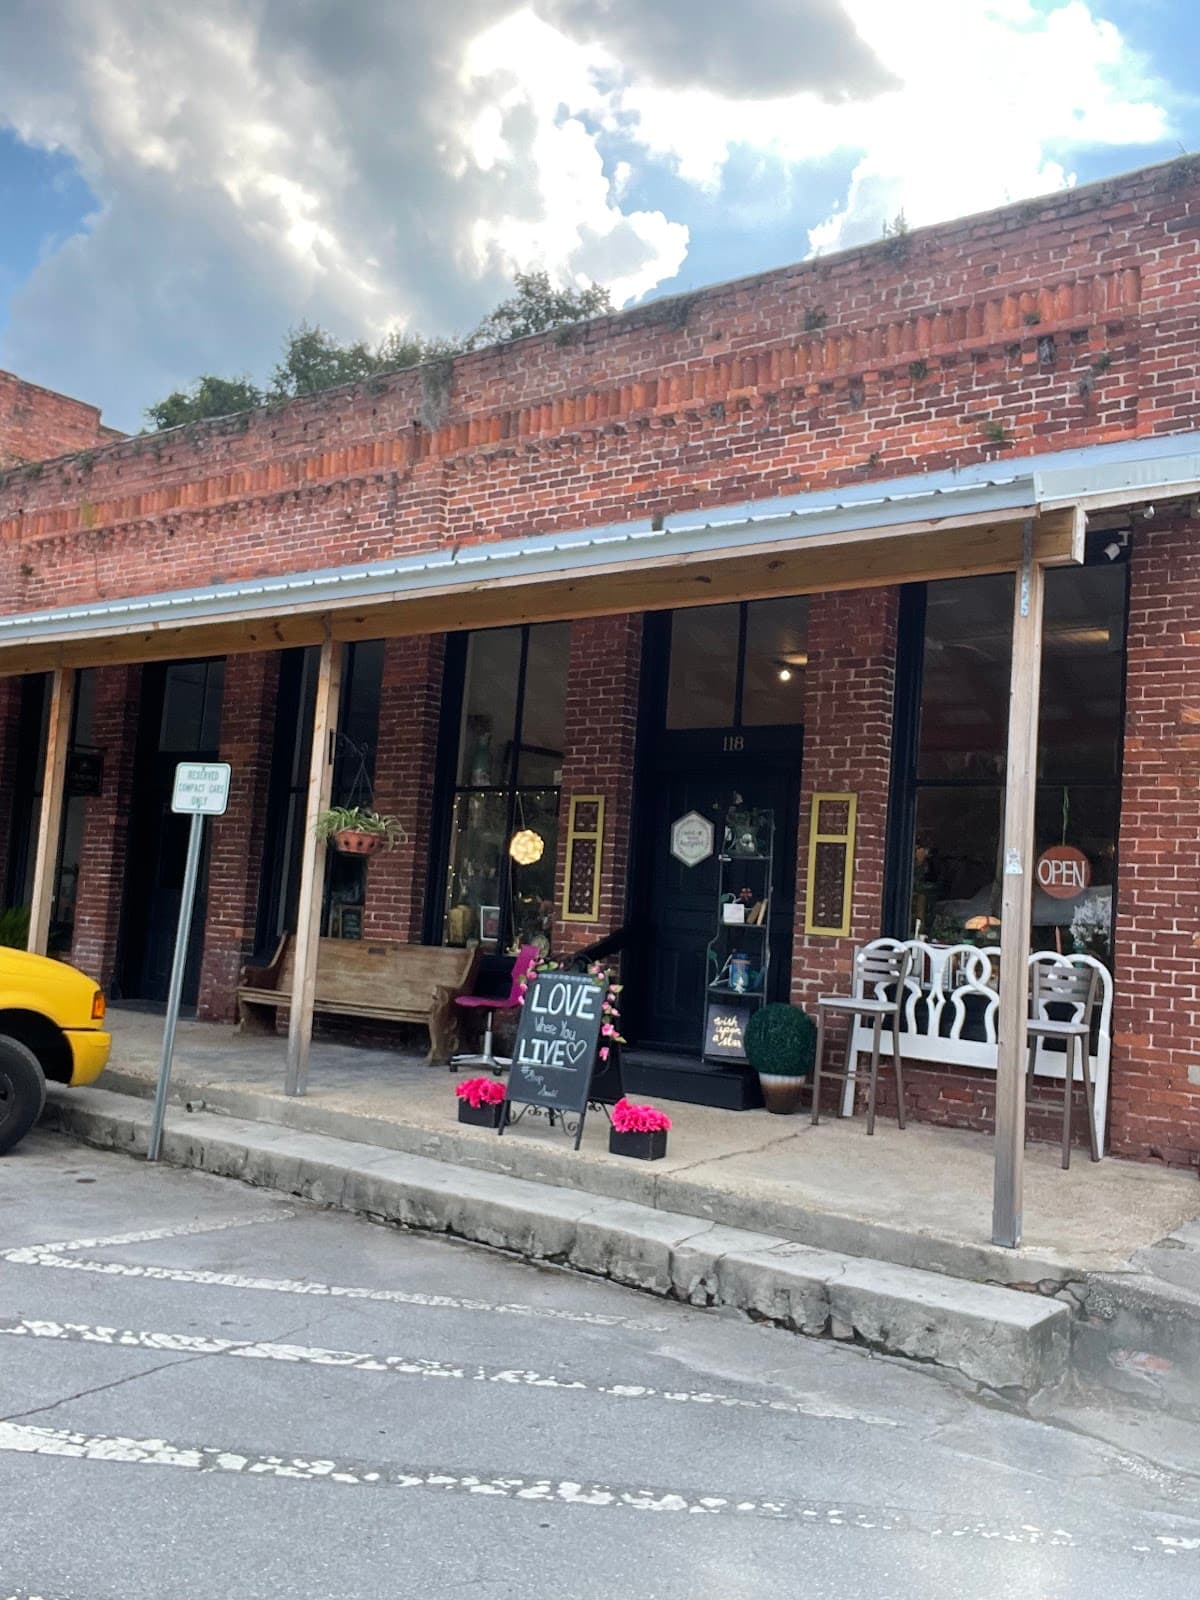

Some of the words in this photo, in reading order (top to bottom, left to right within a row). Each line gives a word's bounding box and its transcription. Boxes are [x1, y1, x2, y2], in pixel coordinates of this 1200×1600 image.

[724, 735, 745, 751] 118
[188, 770, 219, 781] RESERVED
[177, 783, 206, 793] COMPACT
[209, 784, 226, 794] CARS
[191, 796, 209, 807] ONLY
[1038, 859, 1086, 888] OPEN
[531, 983, 601, 1020] LOVE
[560, 1020, 577, 1040] You
[519, 1039, 567, 1067] LIVE
